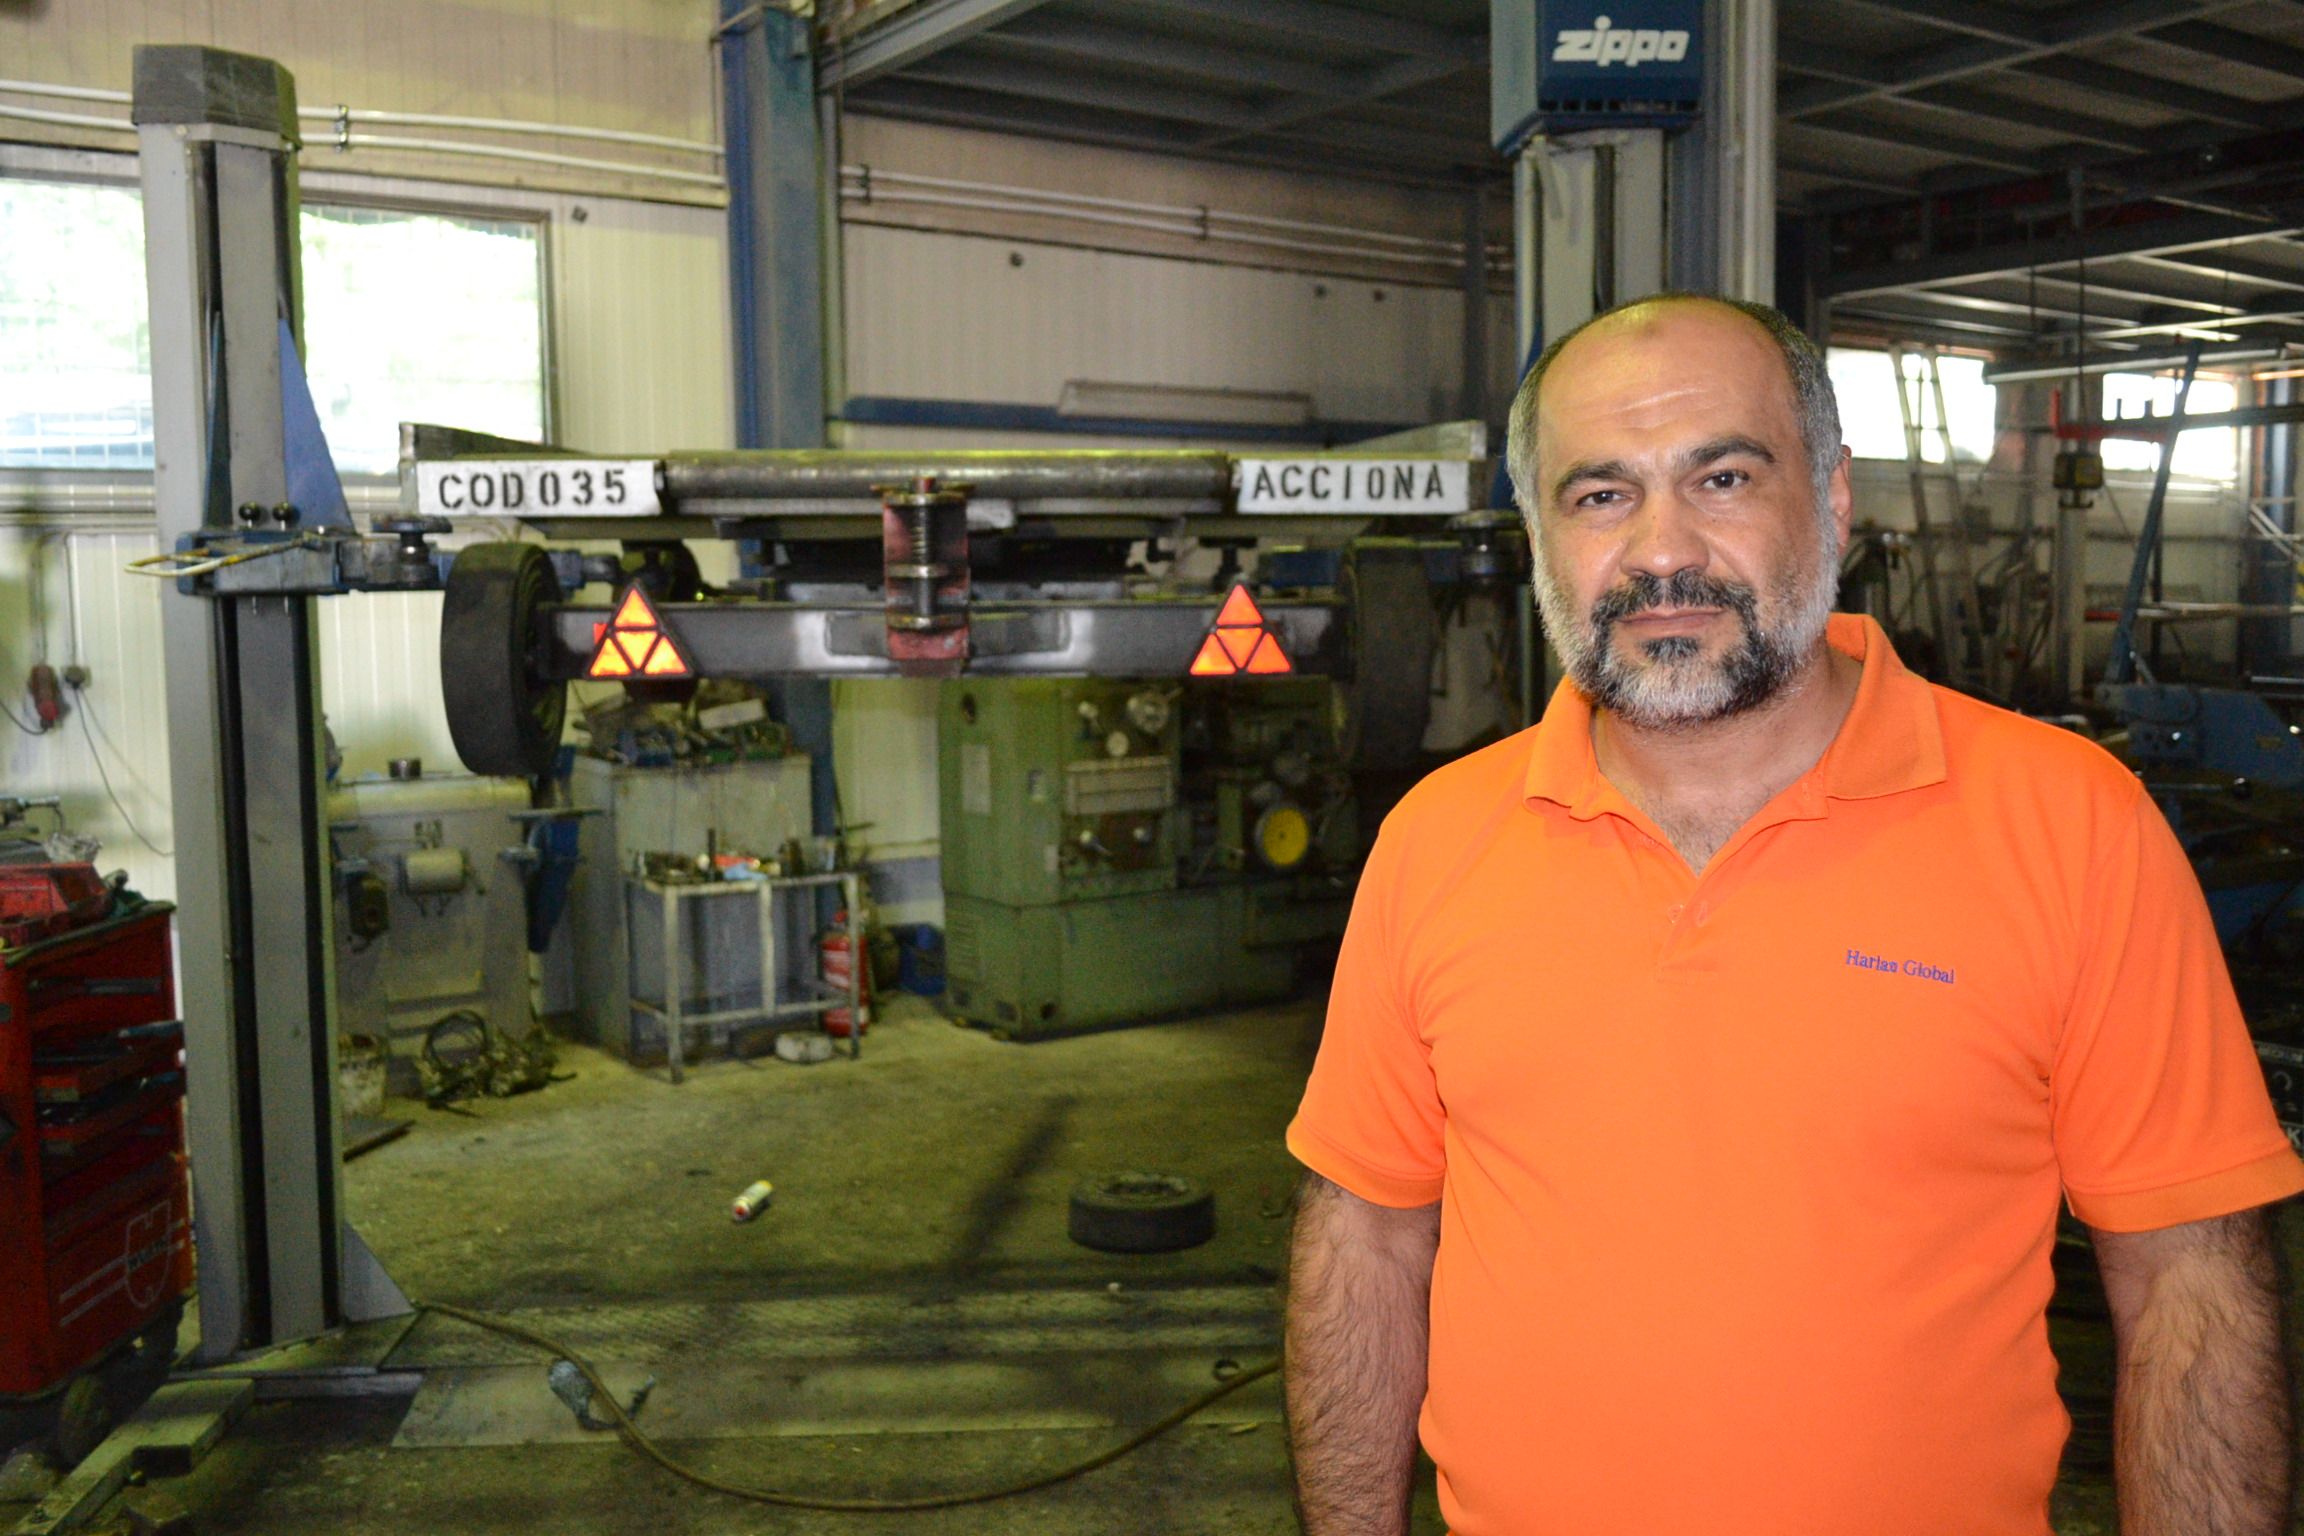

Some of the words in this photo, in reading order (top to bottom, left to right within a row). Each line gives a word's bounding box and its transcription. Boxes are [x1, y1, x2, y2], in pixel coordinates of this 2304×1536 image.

[1552, 15, 1690, 67] zippo
[1253, 463, 1444, 500] ACCIONA
[1903, 959, 1955, 984] Global
